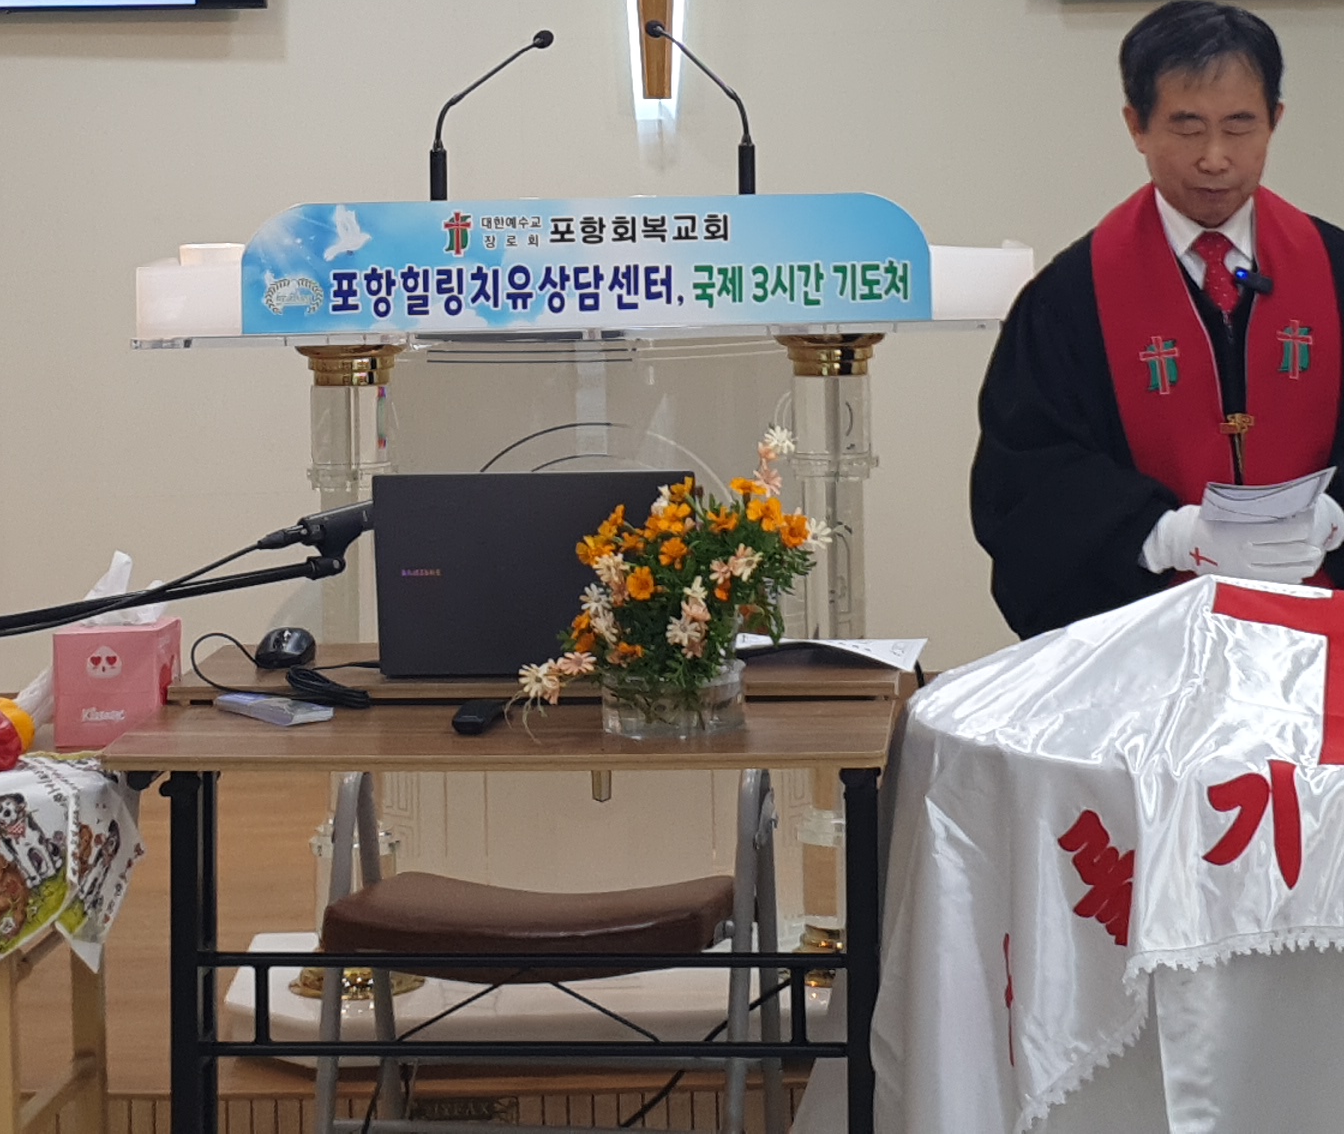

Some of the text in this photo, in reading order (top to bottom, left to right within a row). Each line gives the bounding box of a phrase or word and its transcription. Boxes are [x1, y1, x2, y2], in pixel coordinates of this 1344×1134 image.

[481, 216, 542, 230] 대한예수교
[549, 213, 730, 245] 포항회복교회
[692, 264, 744, 308] 국제
[751, 262, 825, 306] 3시간
[832, 260, 910, 301] 기도처
